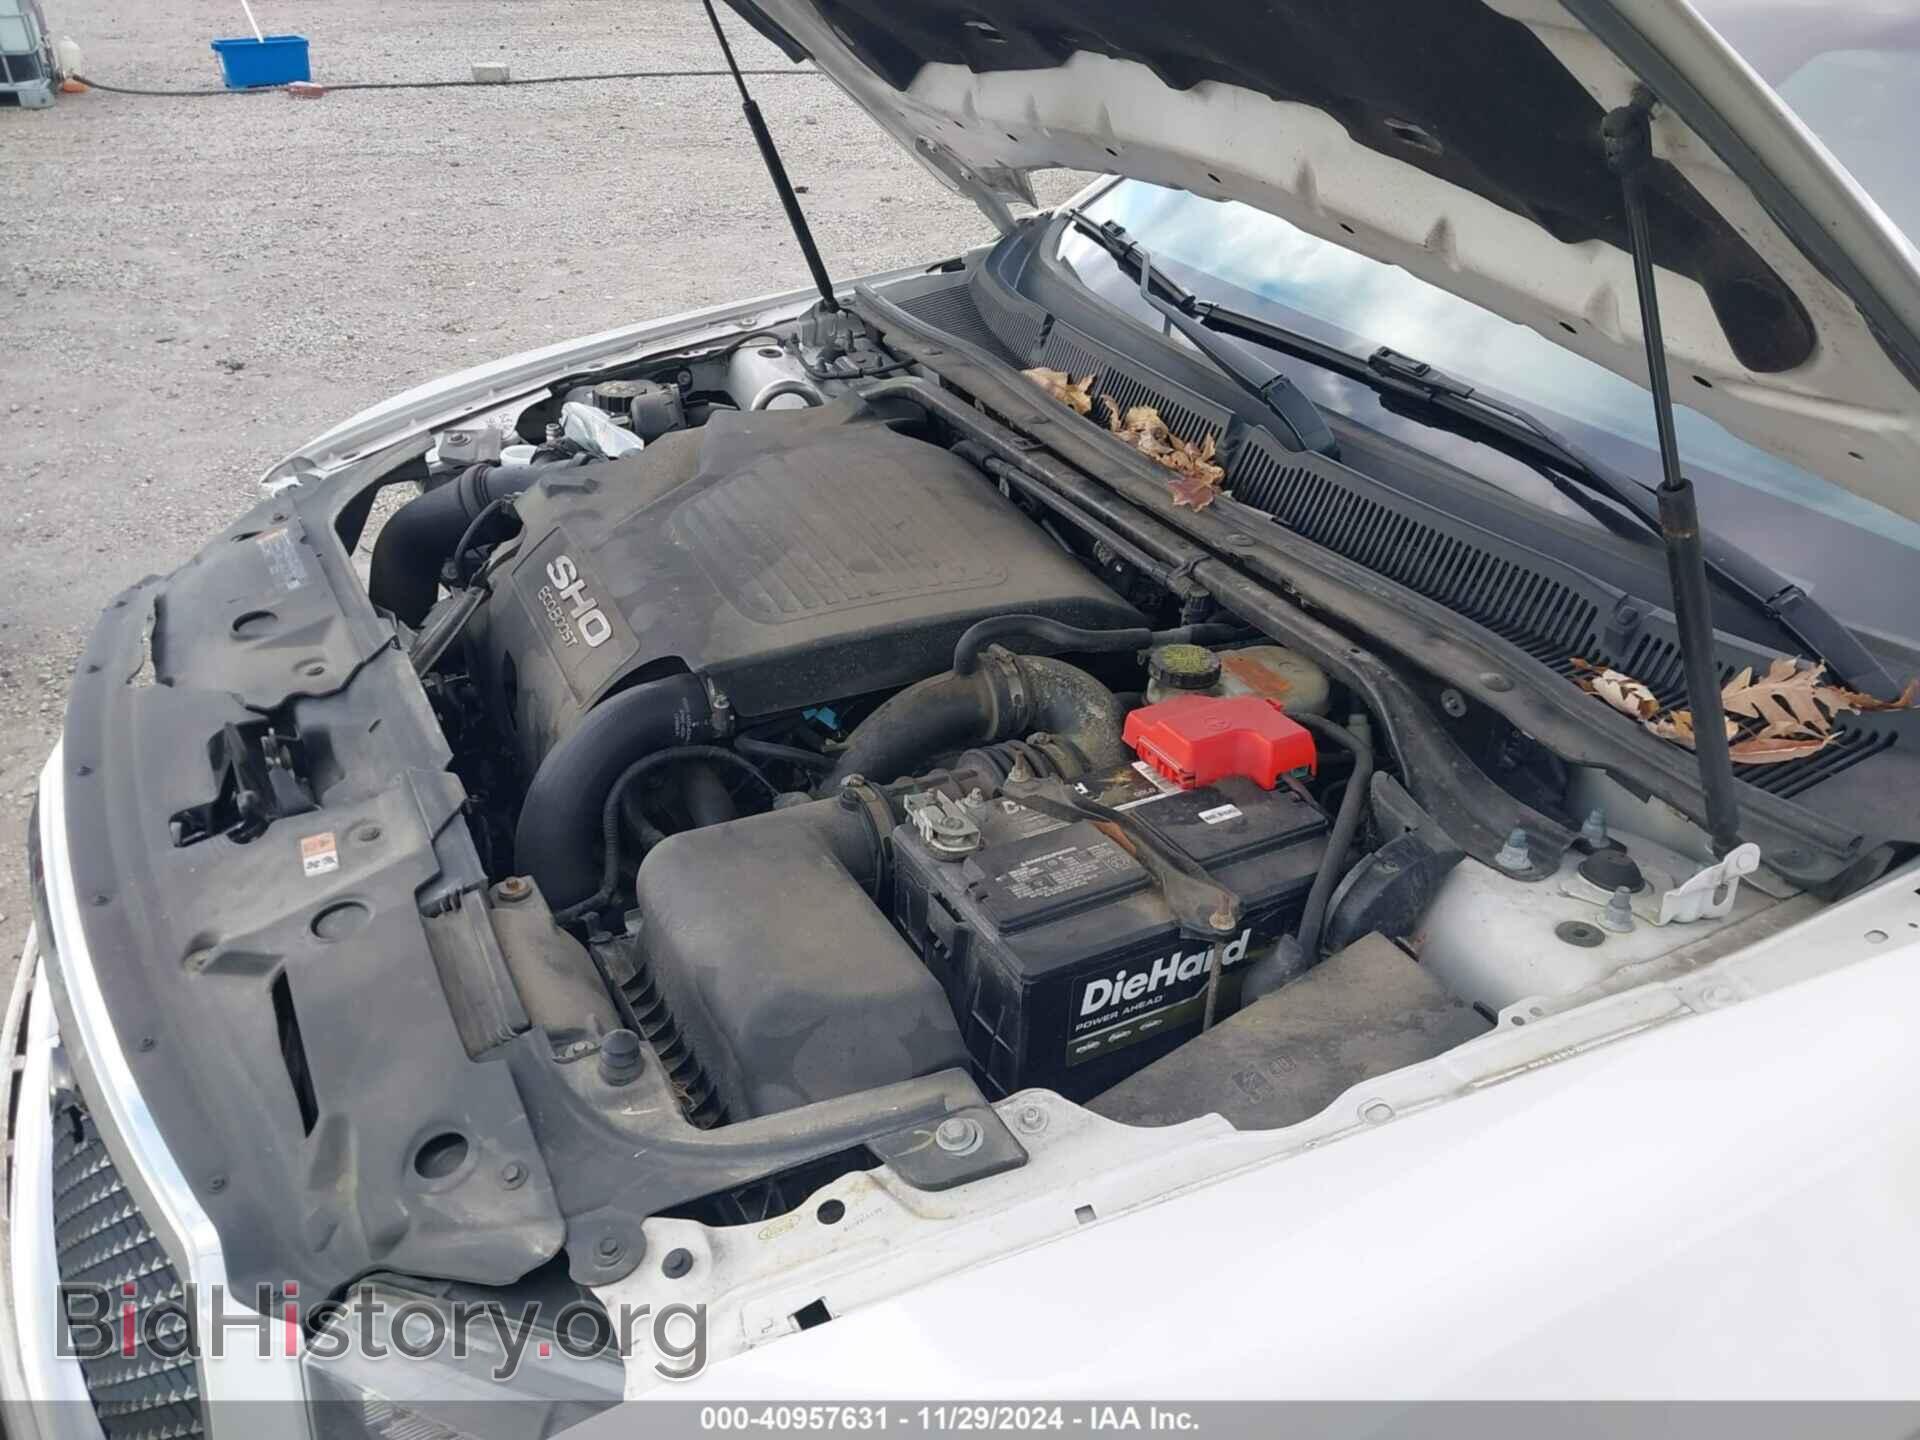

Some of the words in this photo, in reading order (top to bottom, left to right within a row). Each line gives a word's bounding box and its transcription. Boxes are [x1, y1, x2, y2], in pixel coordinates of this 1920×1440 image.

[537, 585, 579, 647] ECOBOOST
[546, 555, 612, 647] SHO
[1080, 928, 1252, 1016] DieHard
[1074, 1011, 1119, 1032] POWER
[1122, 994, 1164, 1016] AHEAD
